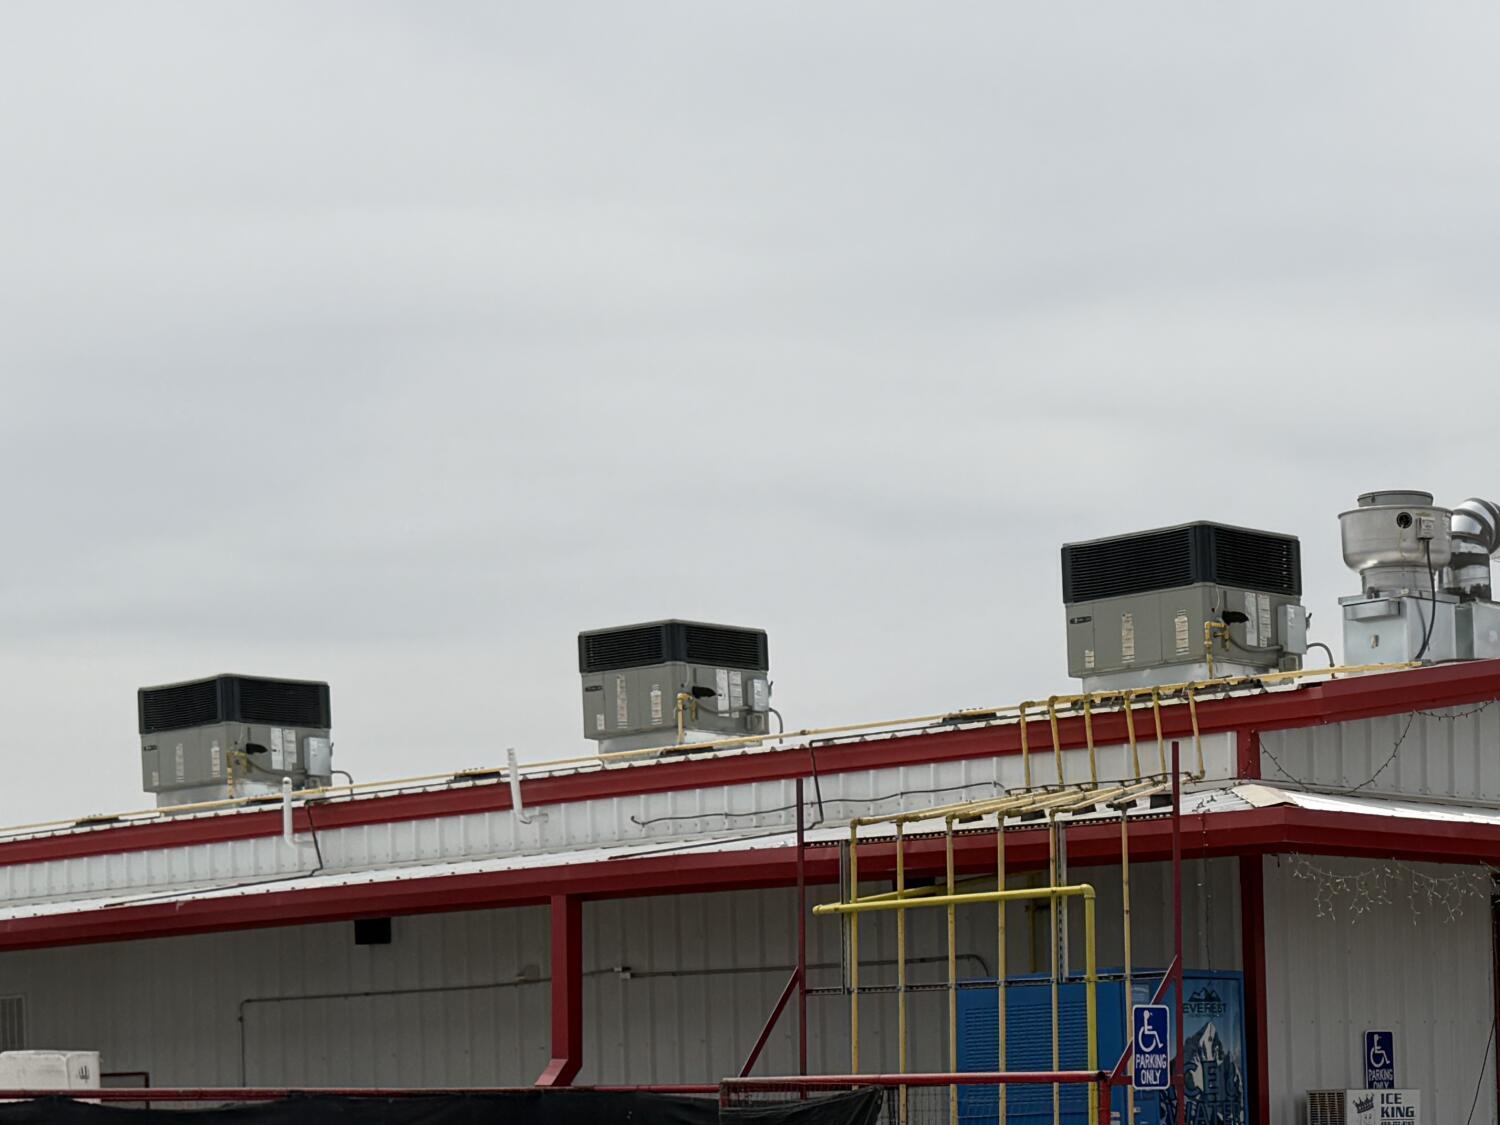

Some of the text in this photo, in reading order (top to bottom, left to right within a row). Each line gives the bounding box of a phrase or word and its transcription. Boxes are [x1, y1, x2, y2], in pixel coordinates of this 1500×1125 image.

[1183, 1002, 1227, 1014] EVEREST
[1135, 1053, 1167, 1069] PARKING
[1140, 1069, 1162, 1085] ONLY
[1368, 1068, 1393, 1081] PARKING
[1381, 1093, 1402, 1105] ICE
[1381, 1105, 1415, 1118] KING
